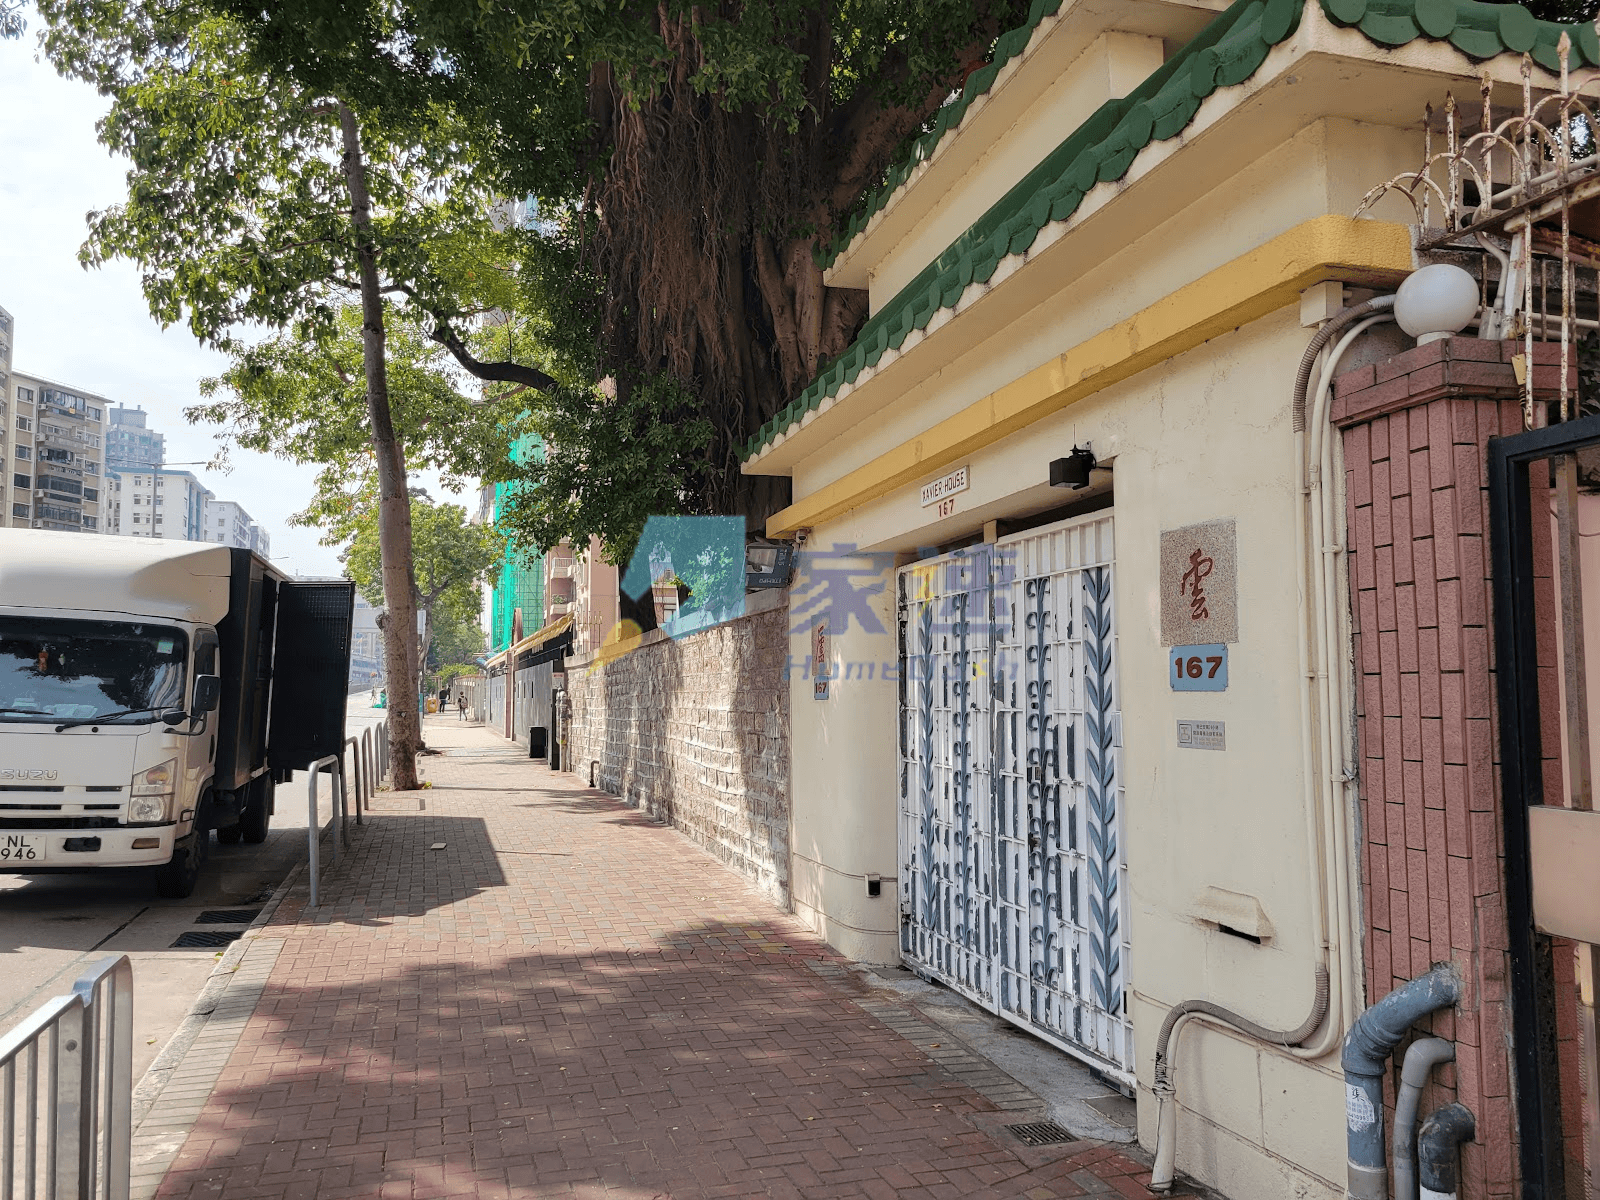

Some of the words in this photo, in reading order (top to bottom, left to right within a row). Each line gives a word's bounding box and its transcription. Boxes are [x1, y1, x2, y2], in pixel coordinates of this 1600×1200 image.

[922, 481, 943, 502] XAVIER
[944, 471, 965, 492] HOUSE
[938, 498, 954, 517] 167
[1175, 656, 1222, 679] 167
[815, 682, 827, 693] 167
[7, 835, 31, 848] NL
[0, 847, 36, 860] 946
